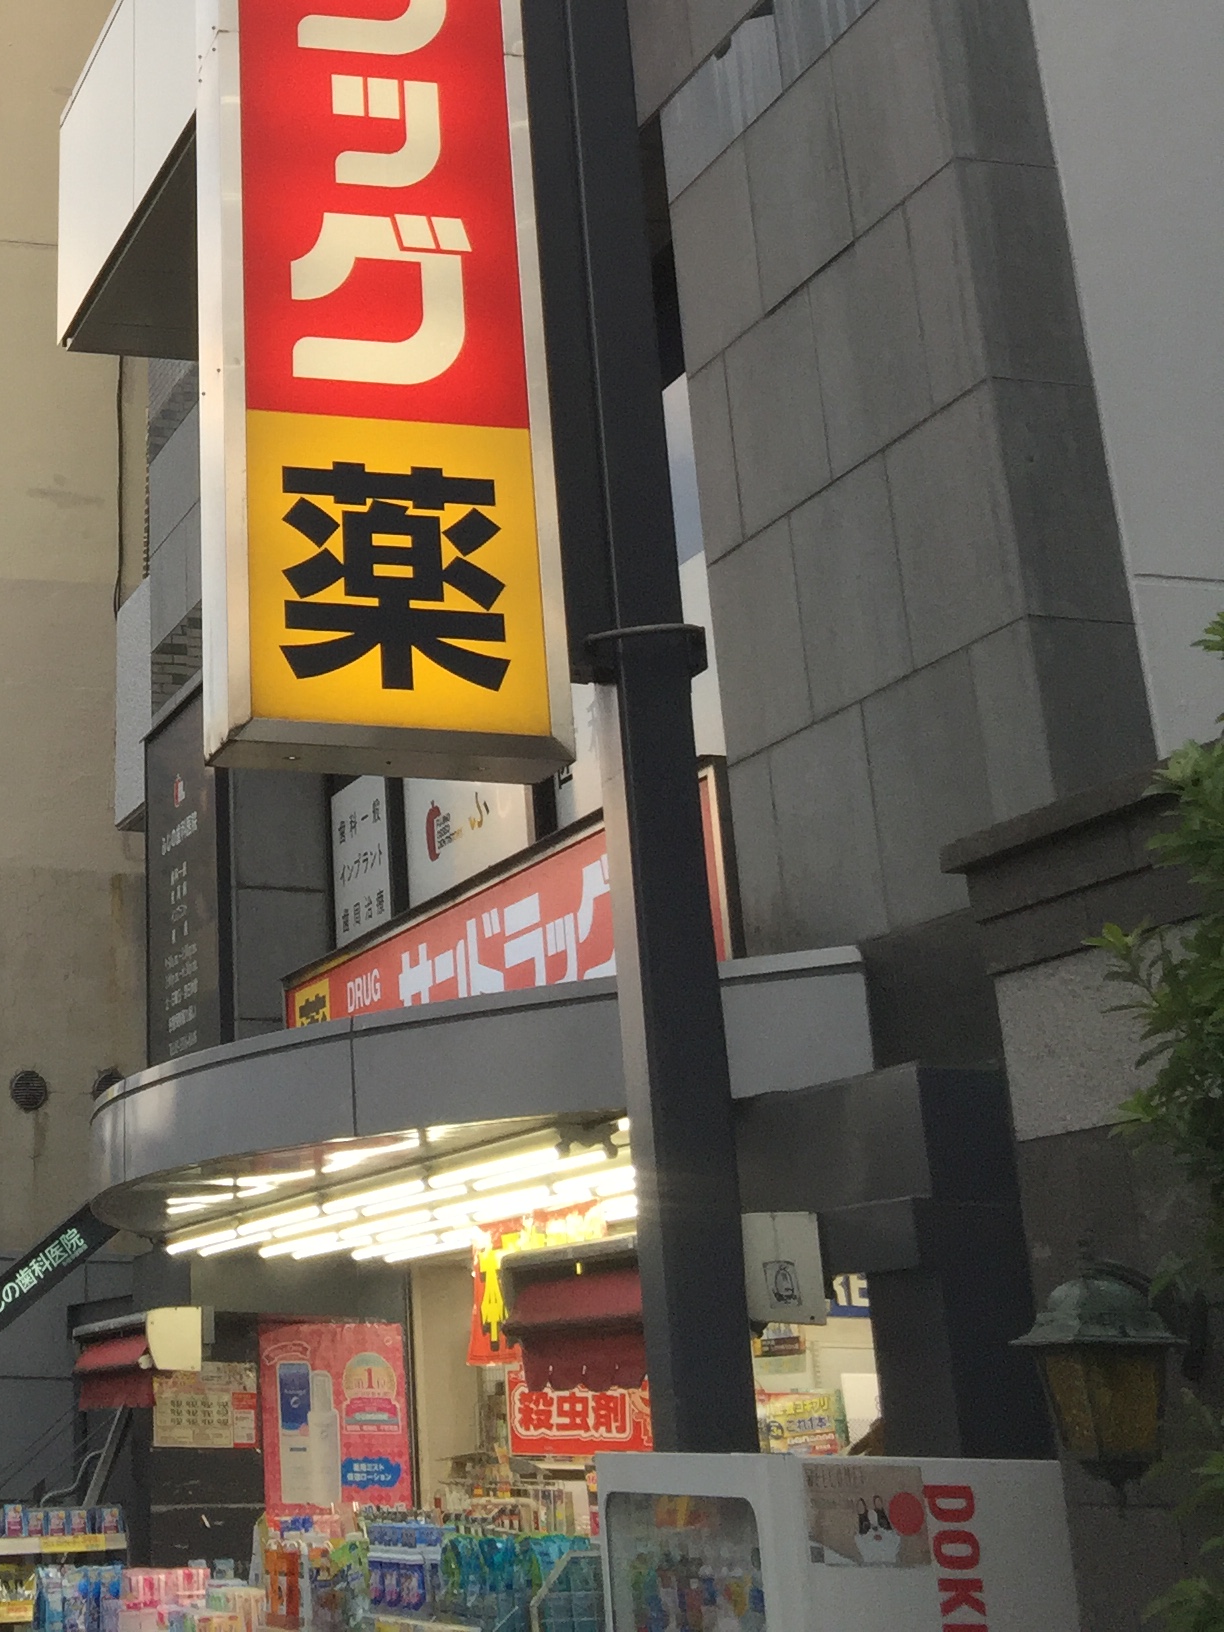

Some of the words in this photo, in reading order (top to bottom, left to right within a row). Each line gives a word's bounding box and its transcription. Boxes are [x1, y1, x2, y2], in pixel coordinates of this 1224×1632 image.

[279, 461, 512, 691] 薬
[339, 842, 383, 888] インプラント
[346, 968, 382, 1013] DRUG
[518, 1390, 626, 1434] 殺虫剤
[922, 1484, 989, 1632] DOK
